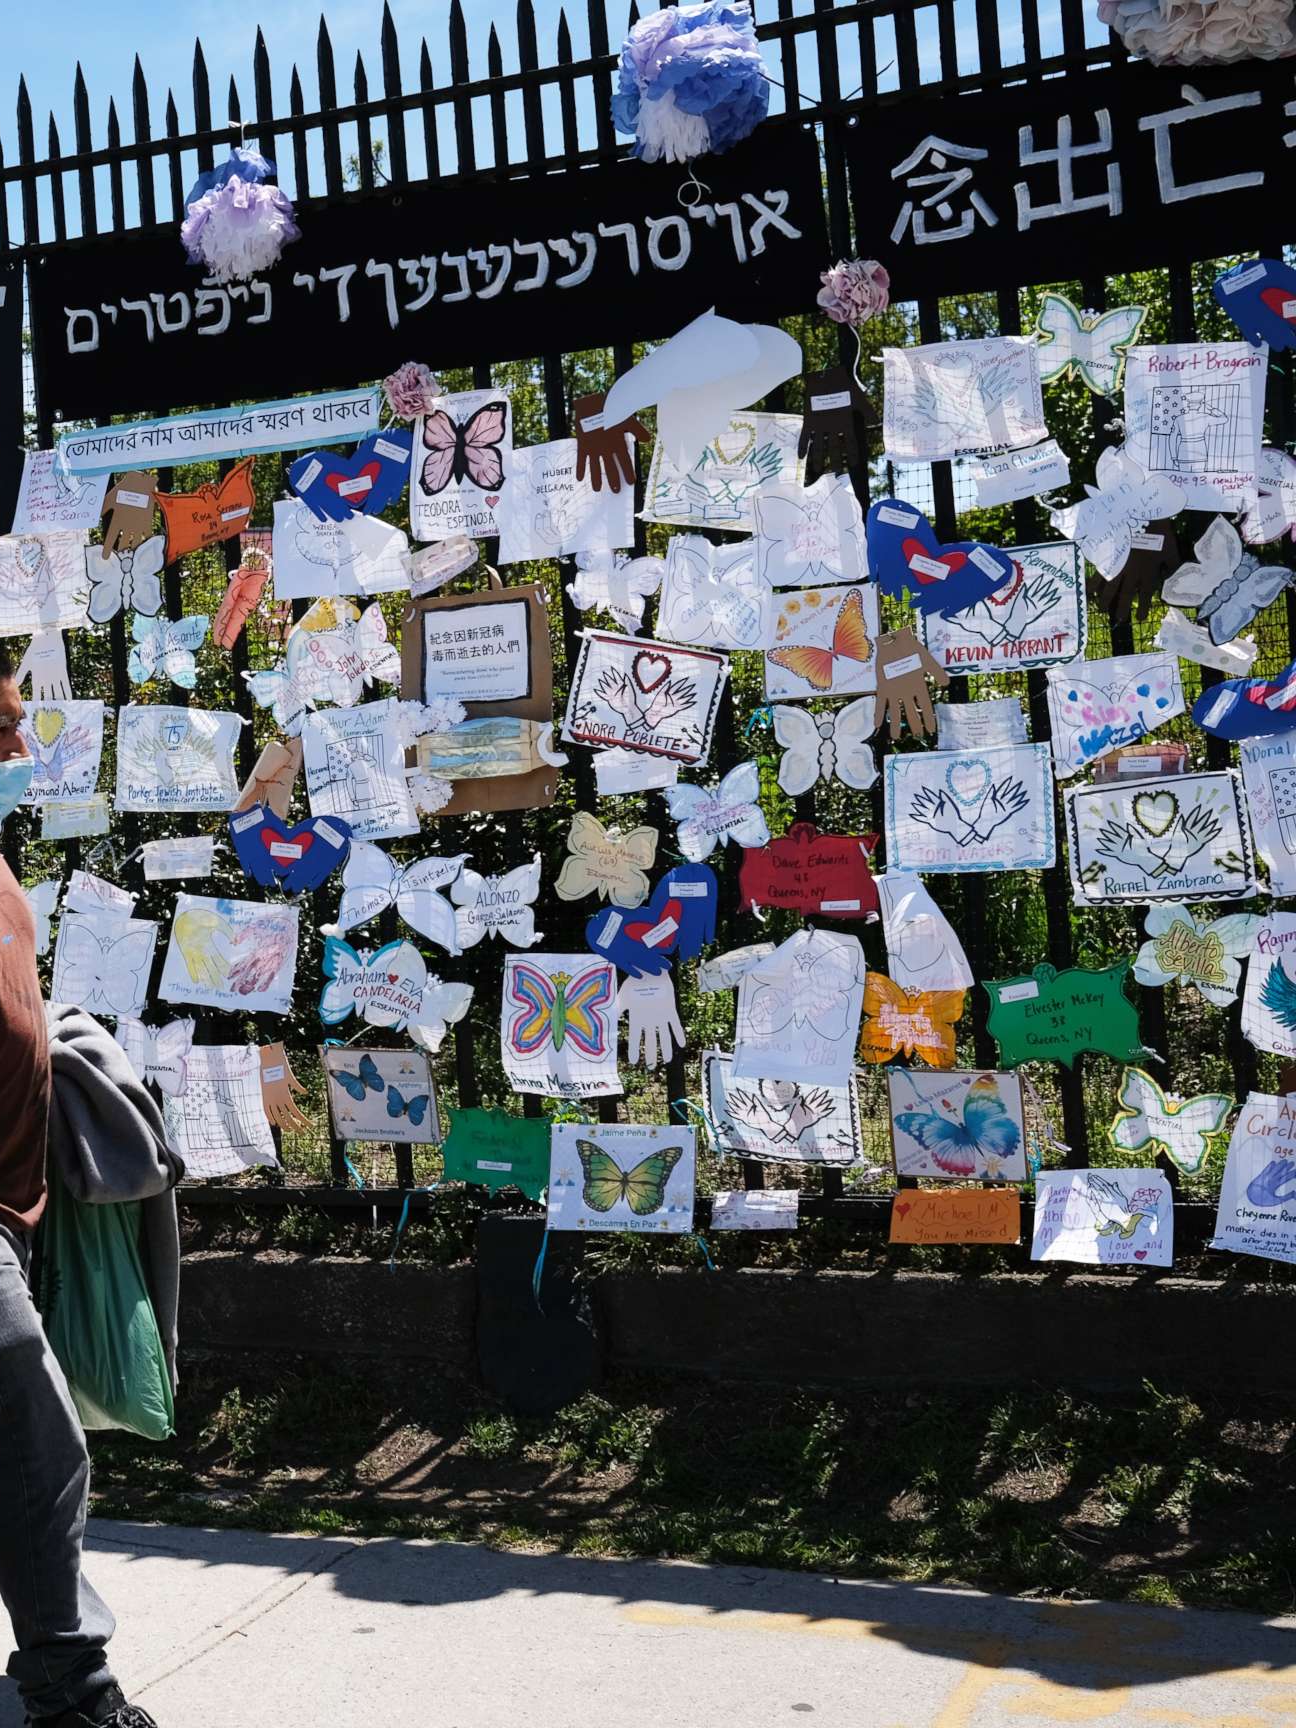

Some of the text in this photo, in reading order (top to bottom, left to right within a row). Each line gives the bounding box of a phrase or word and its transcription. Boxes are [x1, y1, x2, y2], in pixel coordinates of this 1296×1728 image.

[891, 84, 1296, 244] 念出亡
[1148, 353, 1201, 373] Robert
[64, 398, 372, 459] তোমাদের নাম আমাদের স্মরণ থাকবে
[954, 442, 1013, 456] ESSENTIAL
[542, 467, 573, 480] HUBERT
[1168, 475, 1189, 488] age
[536, 483, 575, 495] BELGRAVE
[415, 500, 461, 518] TEODORA
[447, 511, 495, 529] ESPINOSA
[429, 624, 505, 645] 紀念因新冠病
[432, 639, 521, 662] 毒而逝去的人們
[945, 633, 1070, 665] KEVIN TARRANT
[336, 651, 359, 672] John
[345, 660, 370, 683] Toledo
[164, 725, 185, 745] 75
[583, 721, 682, 751] NORA POBLETE
[22, 784, 60, 801] aymond
[128, 783, 219, 800] Parker Jewish Institute
[705, 816, 747, 836] ESSENTIAL
[772, 854, 849, 869] Dave Edwards
[810, 886, 826, 899] NY
[1104, 872, 1225, 895] RAFAEL Zambrano
[344, 894, 386, 923] Thomas
[473, 889, 521, 908] ALONZO
[1160, 926, 1220, 958] Alberto
[1161, 949, 1224, 978] Sevilla
[337, 967, 388, 986] Abraham
[353, 984, 422, 1014] CANDELARIA
[399, 978, 424, 1002] EVA
[369, 1000, 411, 1020] ESSENTIAL
[1074, 1026, 1093, 1042] NY
[510, 1071, 609, 1091] Anna Messina
[599, 1127, 647, 1138] Jaime Peña
[921, 1201, 982, 1222] Michael
[1235, 1208, 1277, 1222] Cheyenne
[630, 1219, 641, 1228] En
[642, 1220, 658, 1229] Paz
[914, 1227, 938, 1241] You
[1144, 1239, 1163, 1249] and
